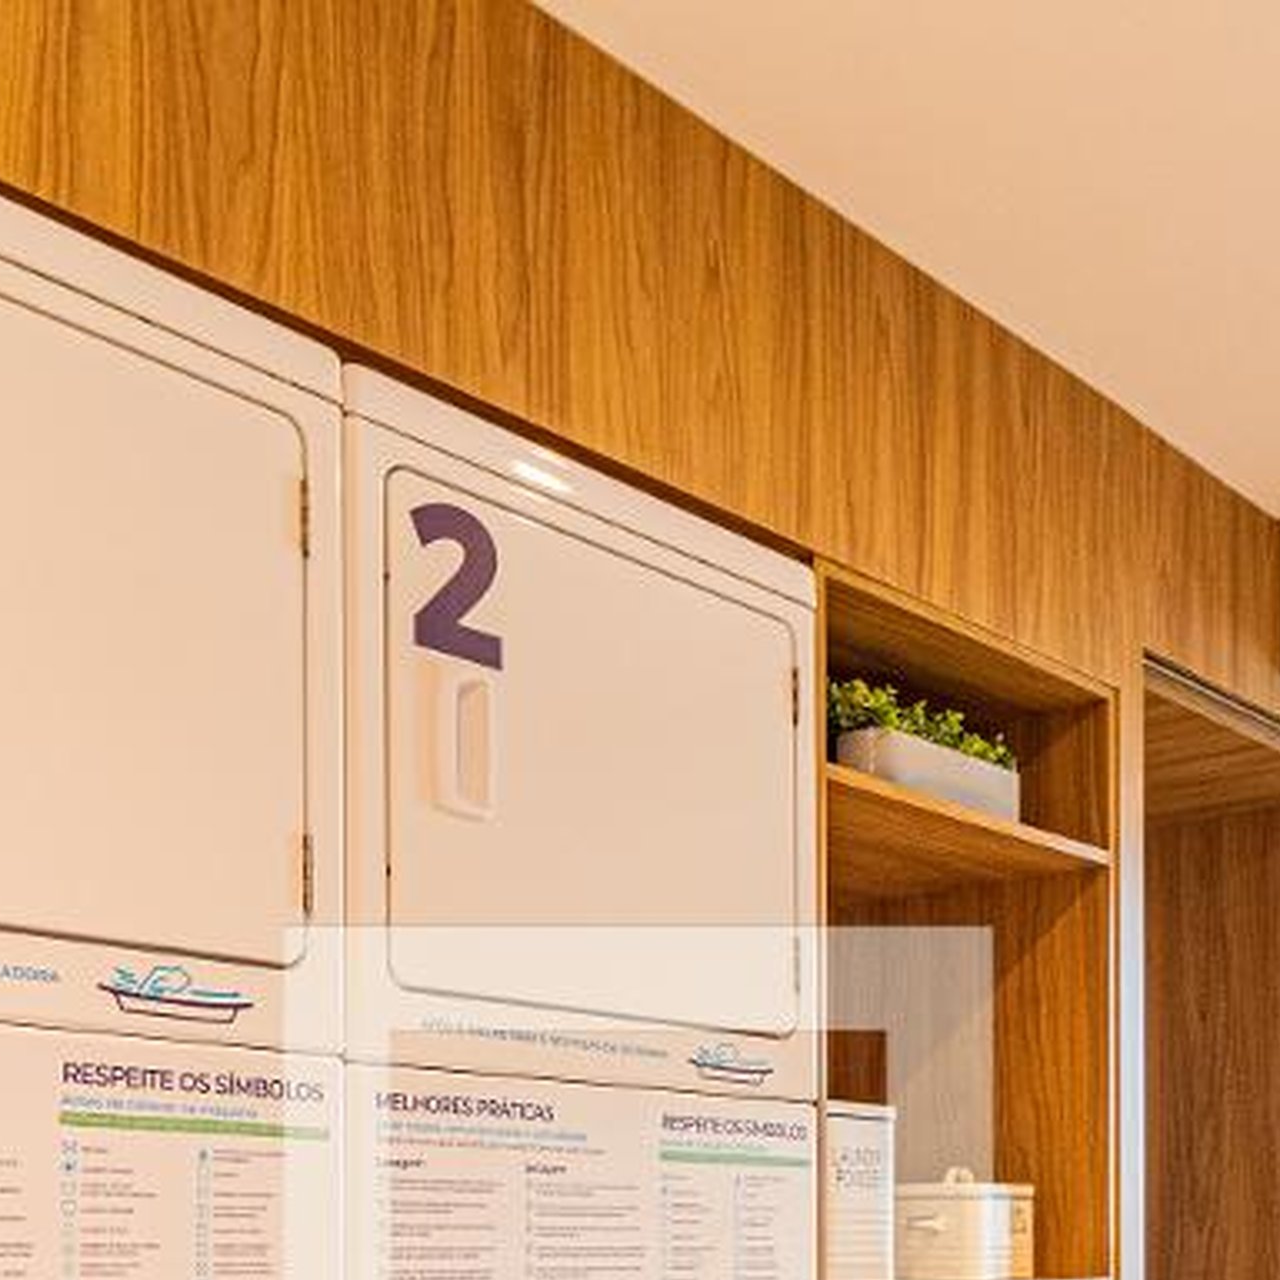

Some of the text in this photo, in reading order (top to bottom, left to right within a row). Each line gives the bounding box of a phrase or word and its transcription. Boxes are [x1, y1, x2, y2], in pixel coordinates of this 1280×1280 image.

[409, 502, 503, 671] 2
[61, 1062, 326, 1102] RESPEITE OS SÍMBOLOS
[375, 1092, 557, 1124] MELHORES PRÁTICAS
[661, 1112, 721, 1135] RESPEITE
